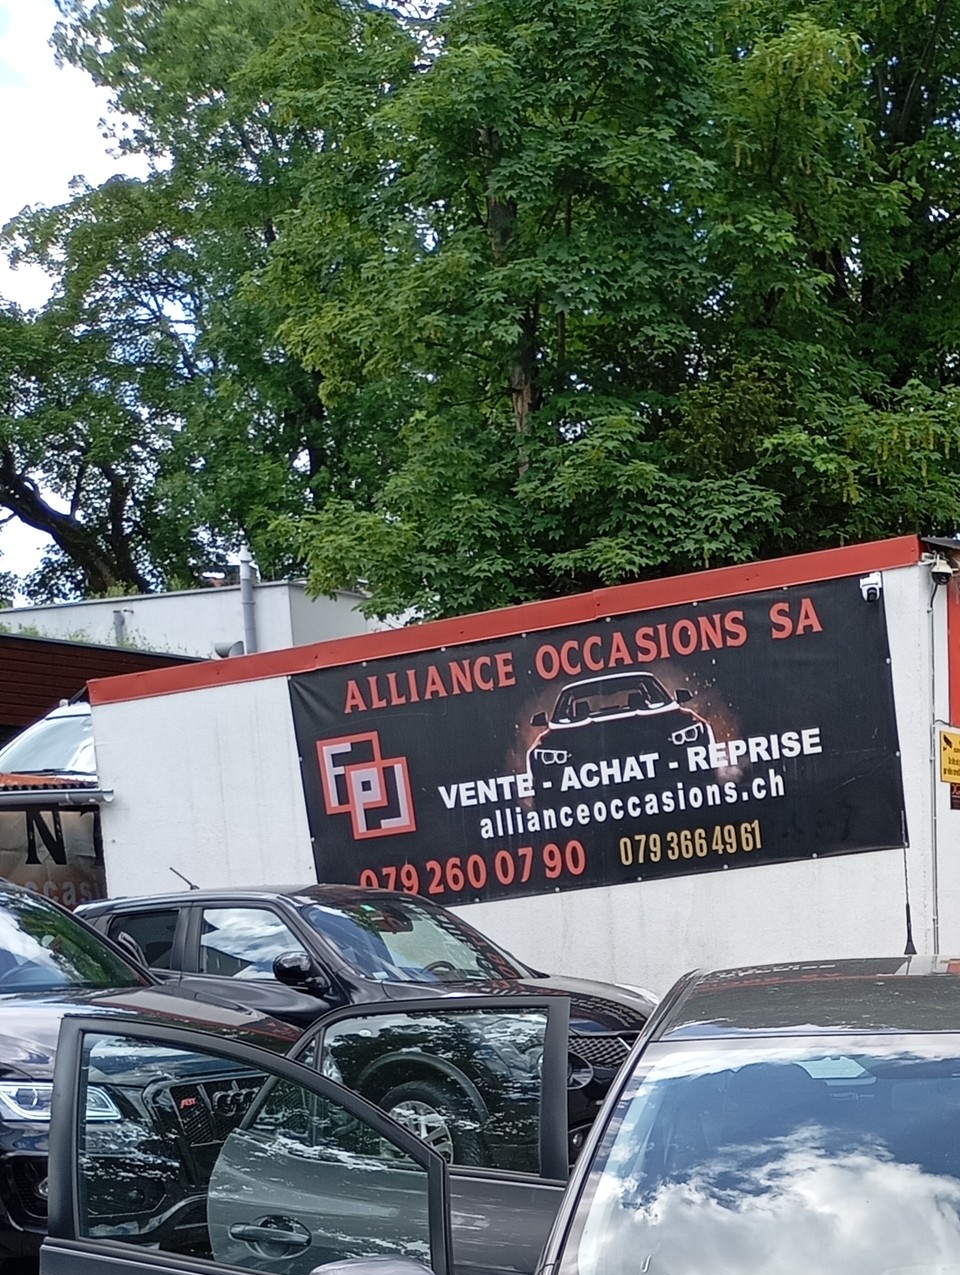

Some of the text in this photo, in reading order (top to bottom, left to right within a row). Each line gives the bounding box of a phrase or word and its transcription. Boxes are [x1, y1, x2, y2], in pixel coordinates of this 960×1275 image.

[343, 597, 824, 715] ALLIANCE OCCASIONS SA
[437, 772, 536, 809] VENTE
[560, 752, 660, 792] ACHAT
[686, 727, 823, 772] REPRISE
[479, 768, 785, 840] allianceoccasions.ch
[359, 839, 587, 896] 079 260 07 90
[619, 819, 763, 866] 079 366 49 61
